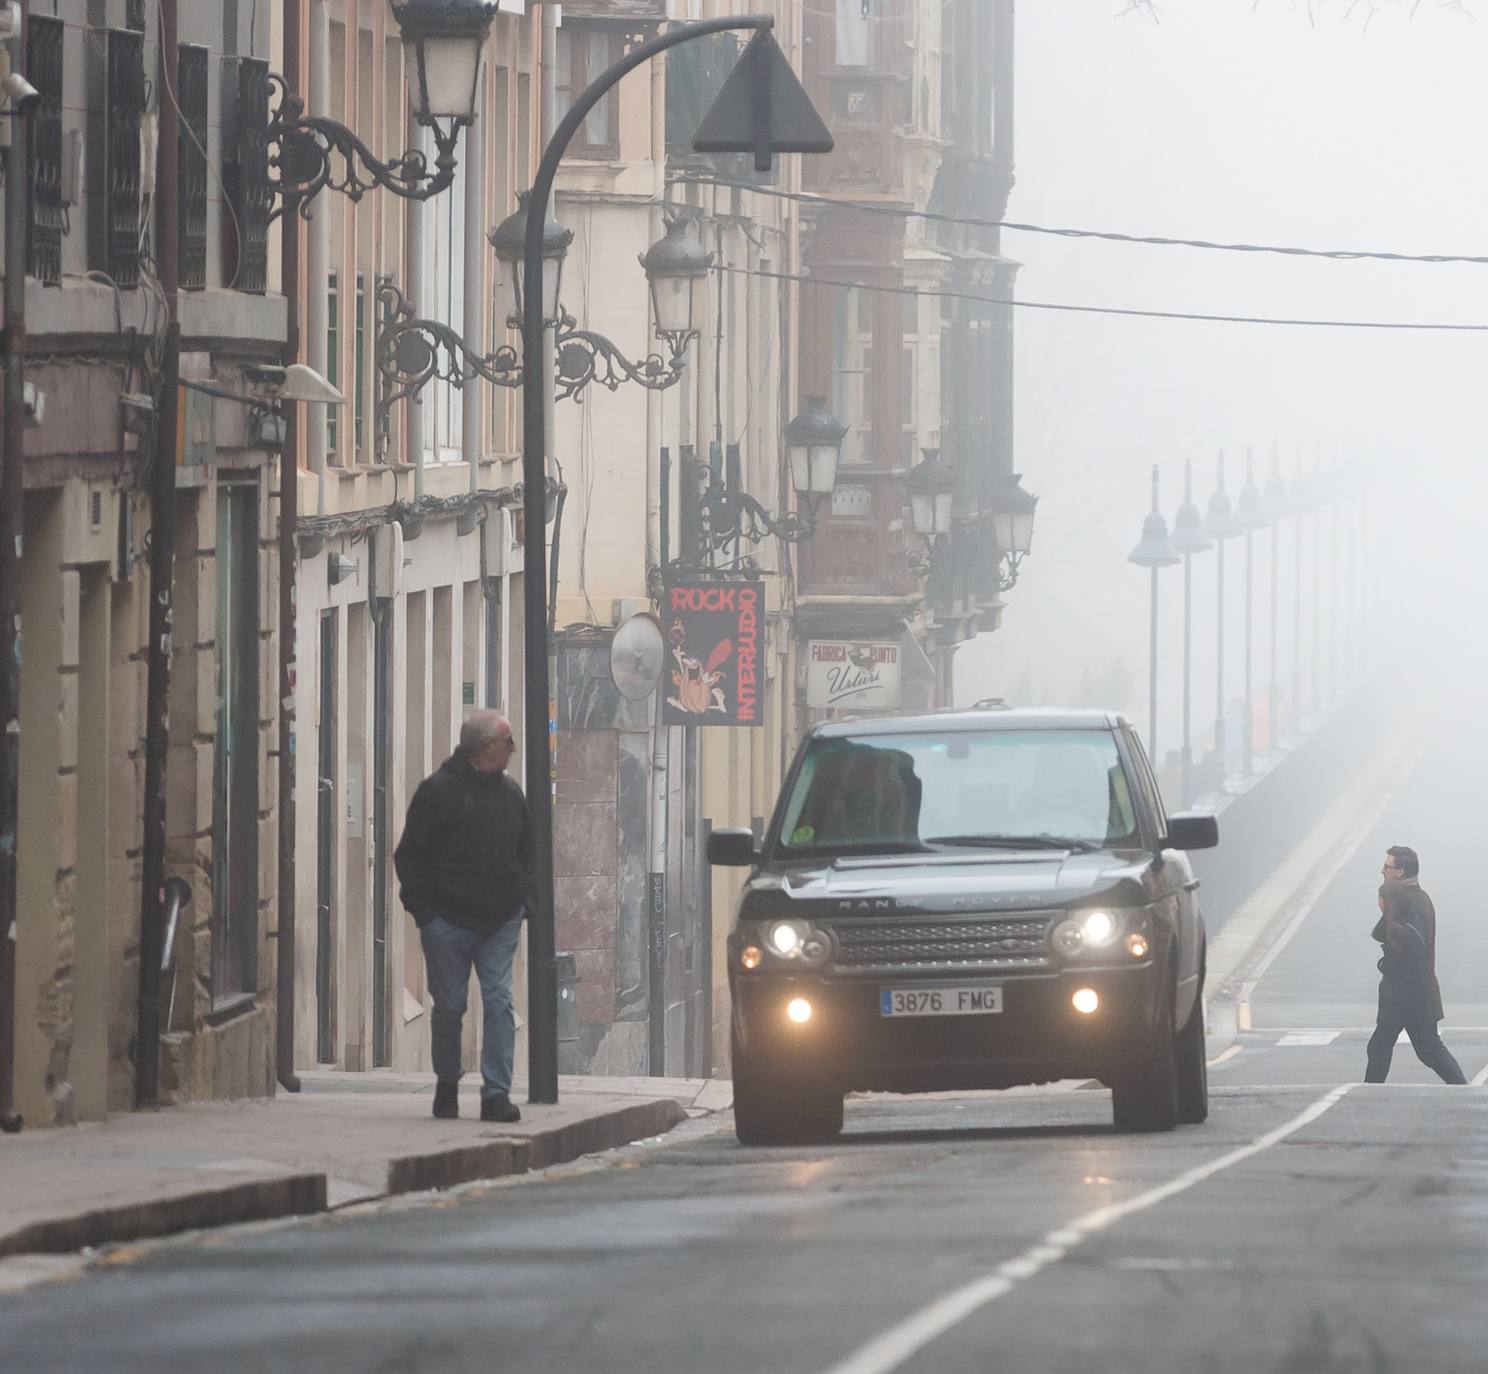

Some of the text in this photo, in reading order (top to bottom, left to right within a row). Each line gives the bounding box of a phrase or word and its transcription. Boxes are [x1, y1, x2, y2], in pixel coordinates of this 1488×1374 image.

[671, 587, 736, 612] ROCK
[736, 588, 757, 720] INTERLUDIO
[894, 990, 996, 1012] 3876 FMG
